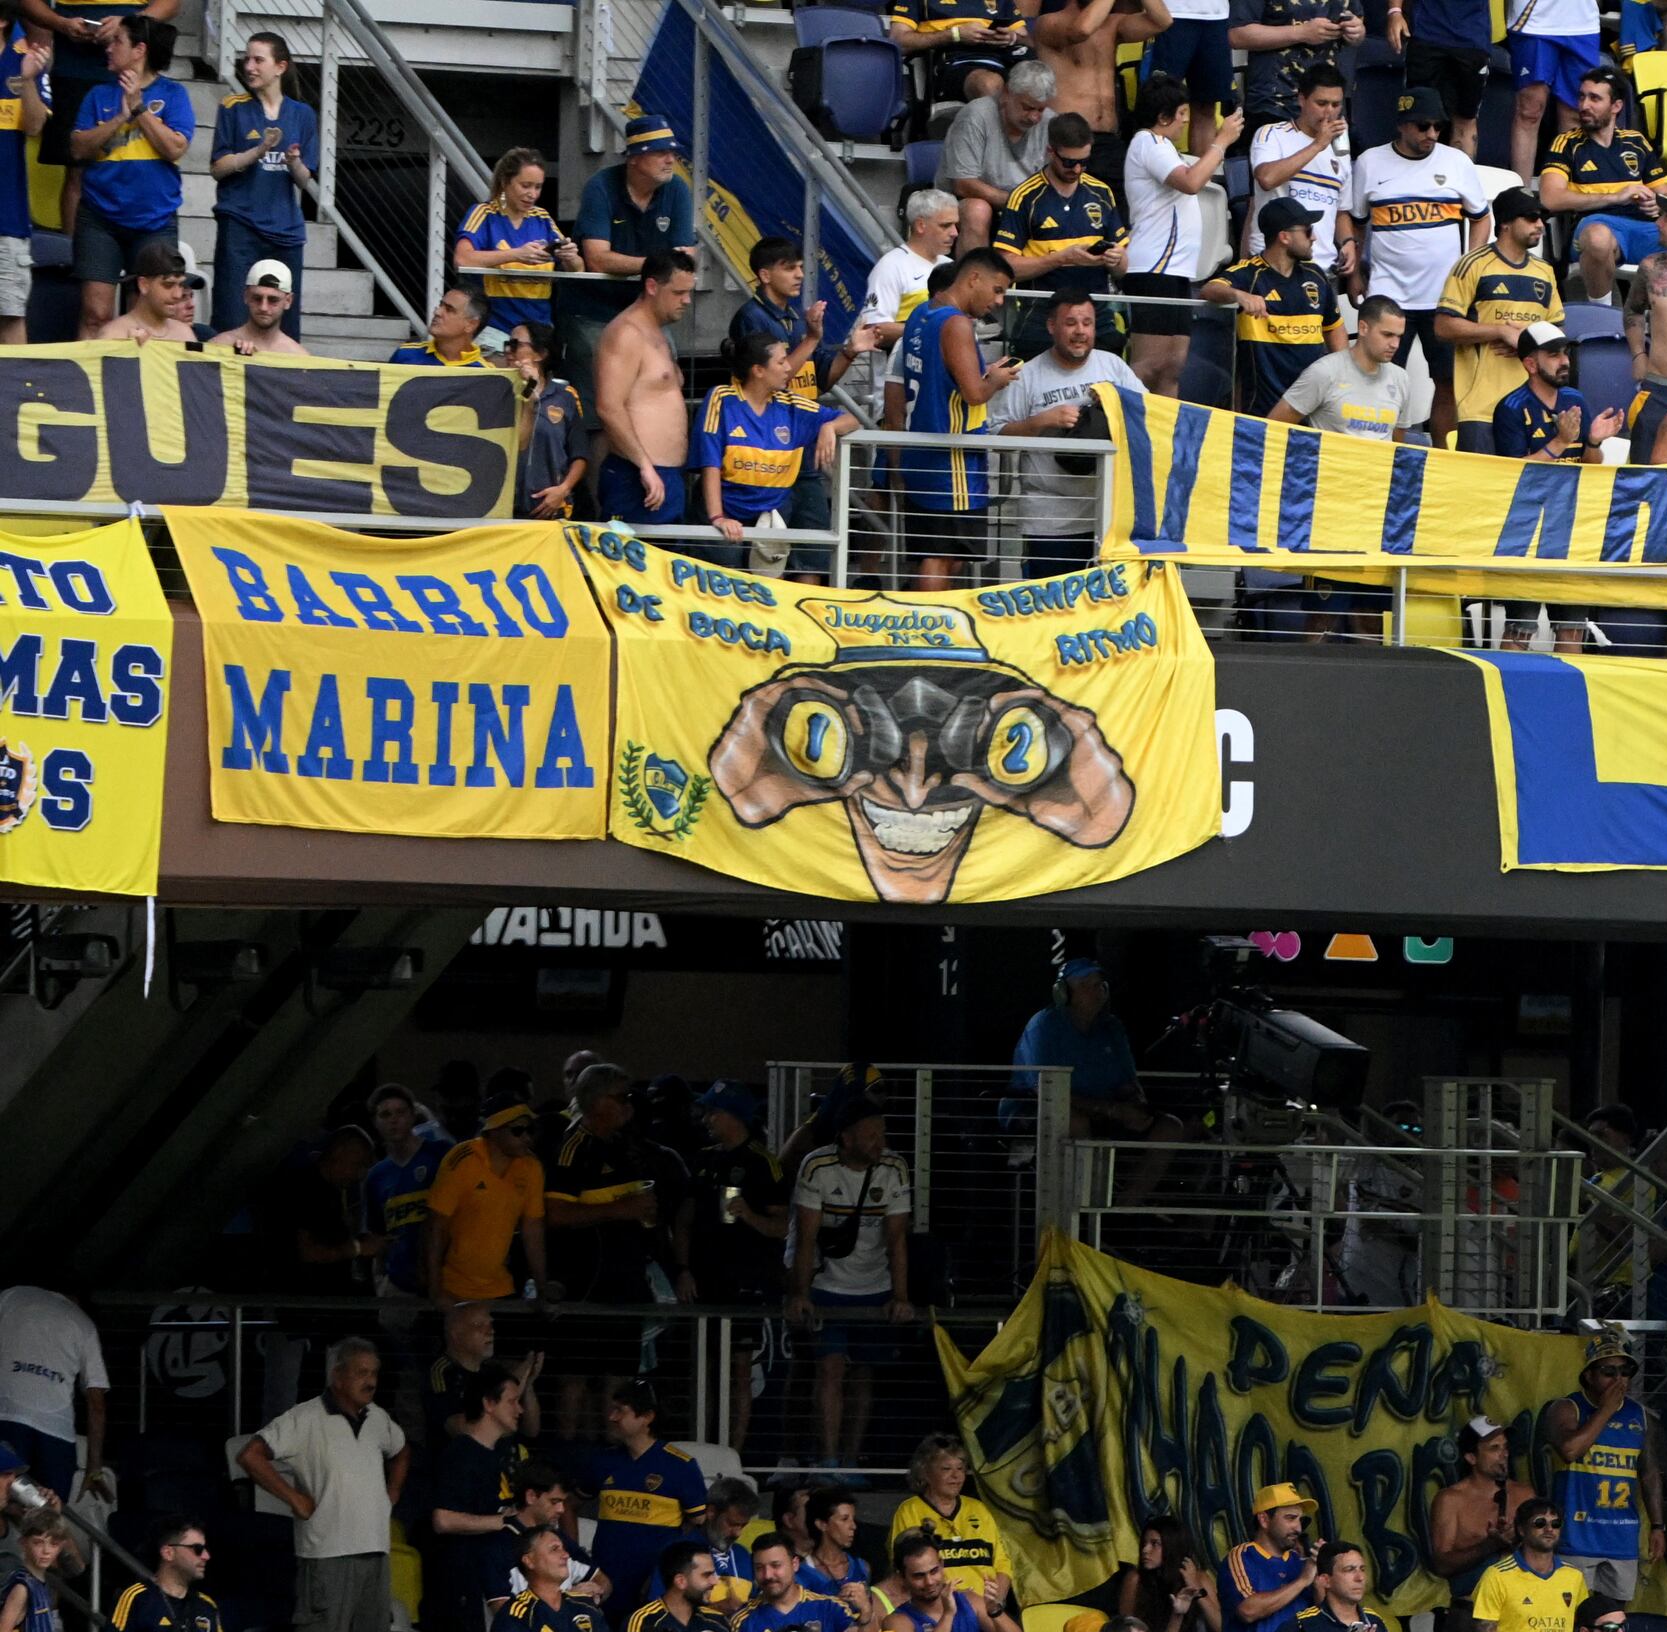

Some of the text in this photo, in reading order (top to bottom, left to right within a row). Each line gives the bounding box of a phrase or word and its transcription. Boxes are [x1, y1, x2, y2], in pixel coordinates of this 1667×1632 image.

[346, 114, 406, 148] 229
[1388, 201, 1443, 224] BBVA
[1266, 320, 1323, 337] betsson
[1041, 387, 1079, 407] JUSTICIA
[733, 458, 792, 476] betsson
[579, 525, 777, 607] LOS PIBES
[0, 553, 117, 617] TO
[211, 546, 571, 639] BARRIO
[977, 568, 1126, 618] SIEMPRE
[616, 584, 792, 656] DE BOCA
[824, 605, 956, 635] Jugador
[1054, 612, 1158, 665] RITMO
[222, 664, 595, 788] MARINA
[605, 1495, 651, 1511] QATAR
[1596, 1479, 1627, 1509] 12
[1527, 1615, 1567, 1630] QATAR
